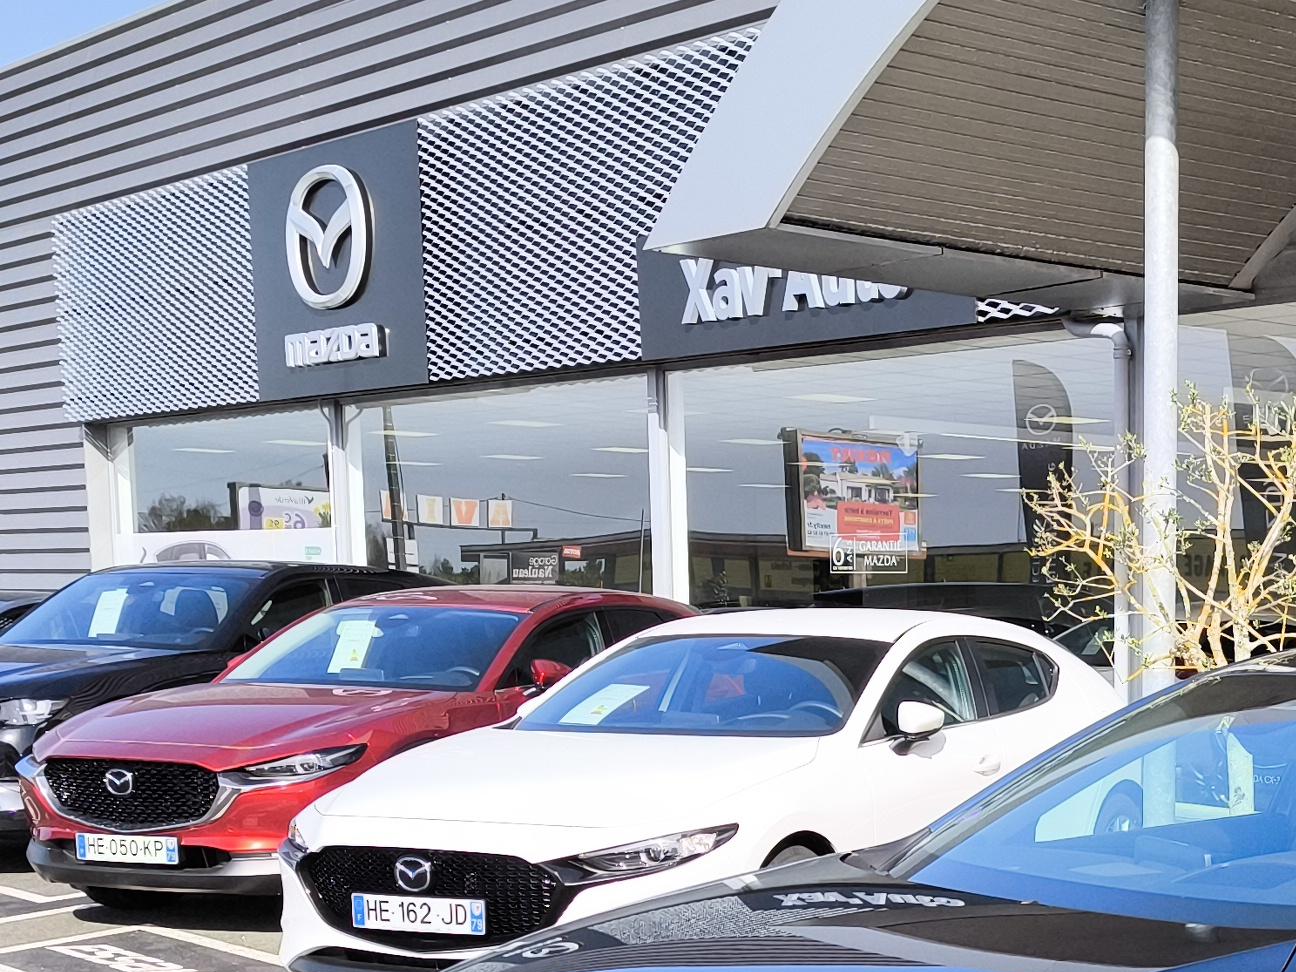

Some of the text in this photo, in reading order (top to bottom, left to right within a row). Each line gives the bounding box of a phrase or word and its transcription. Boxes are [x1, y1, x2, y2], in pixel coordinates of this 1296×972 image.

[833, 536, 845, 566] 6
[859, 541, 901, 551] GARANTIE
[864, 555, 897, 567] MAZDA
